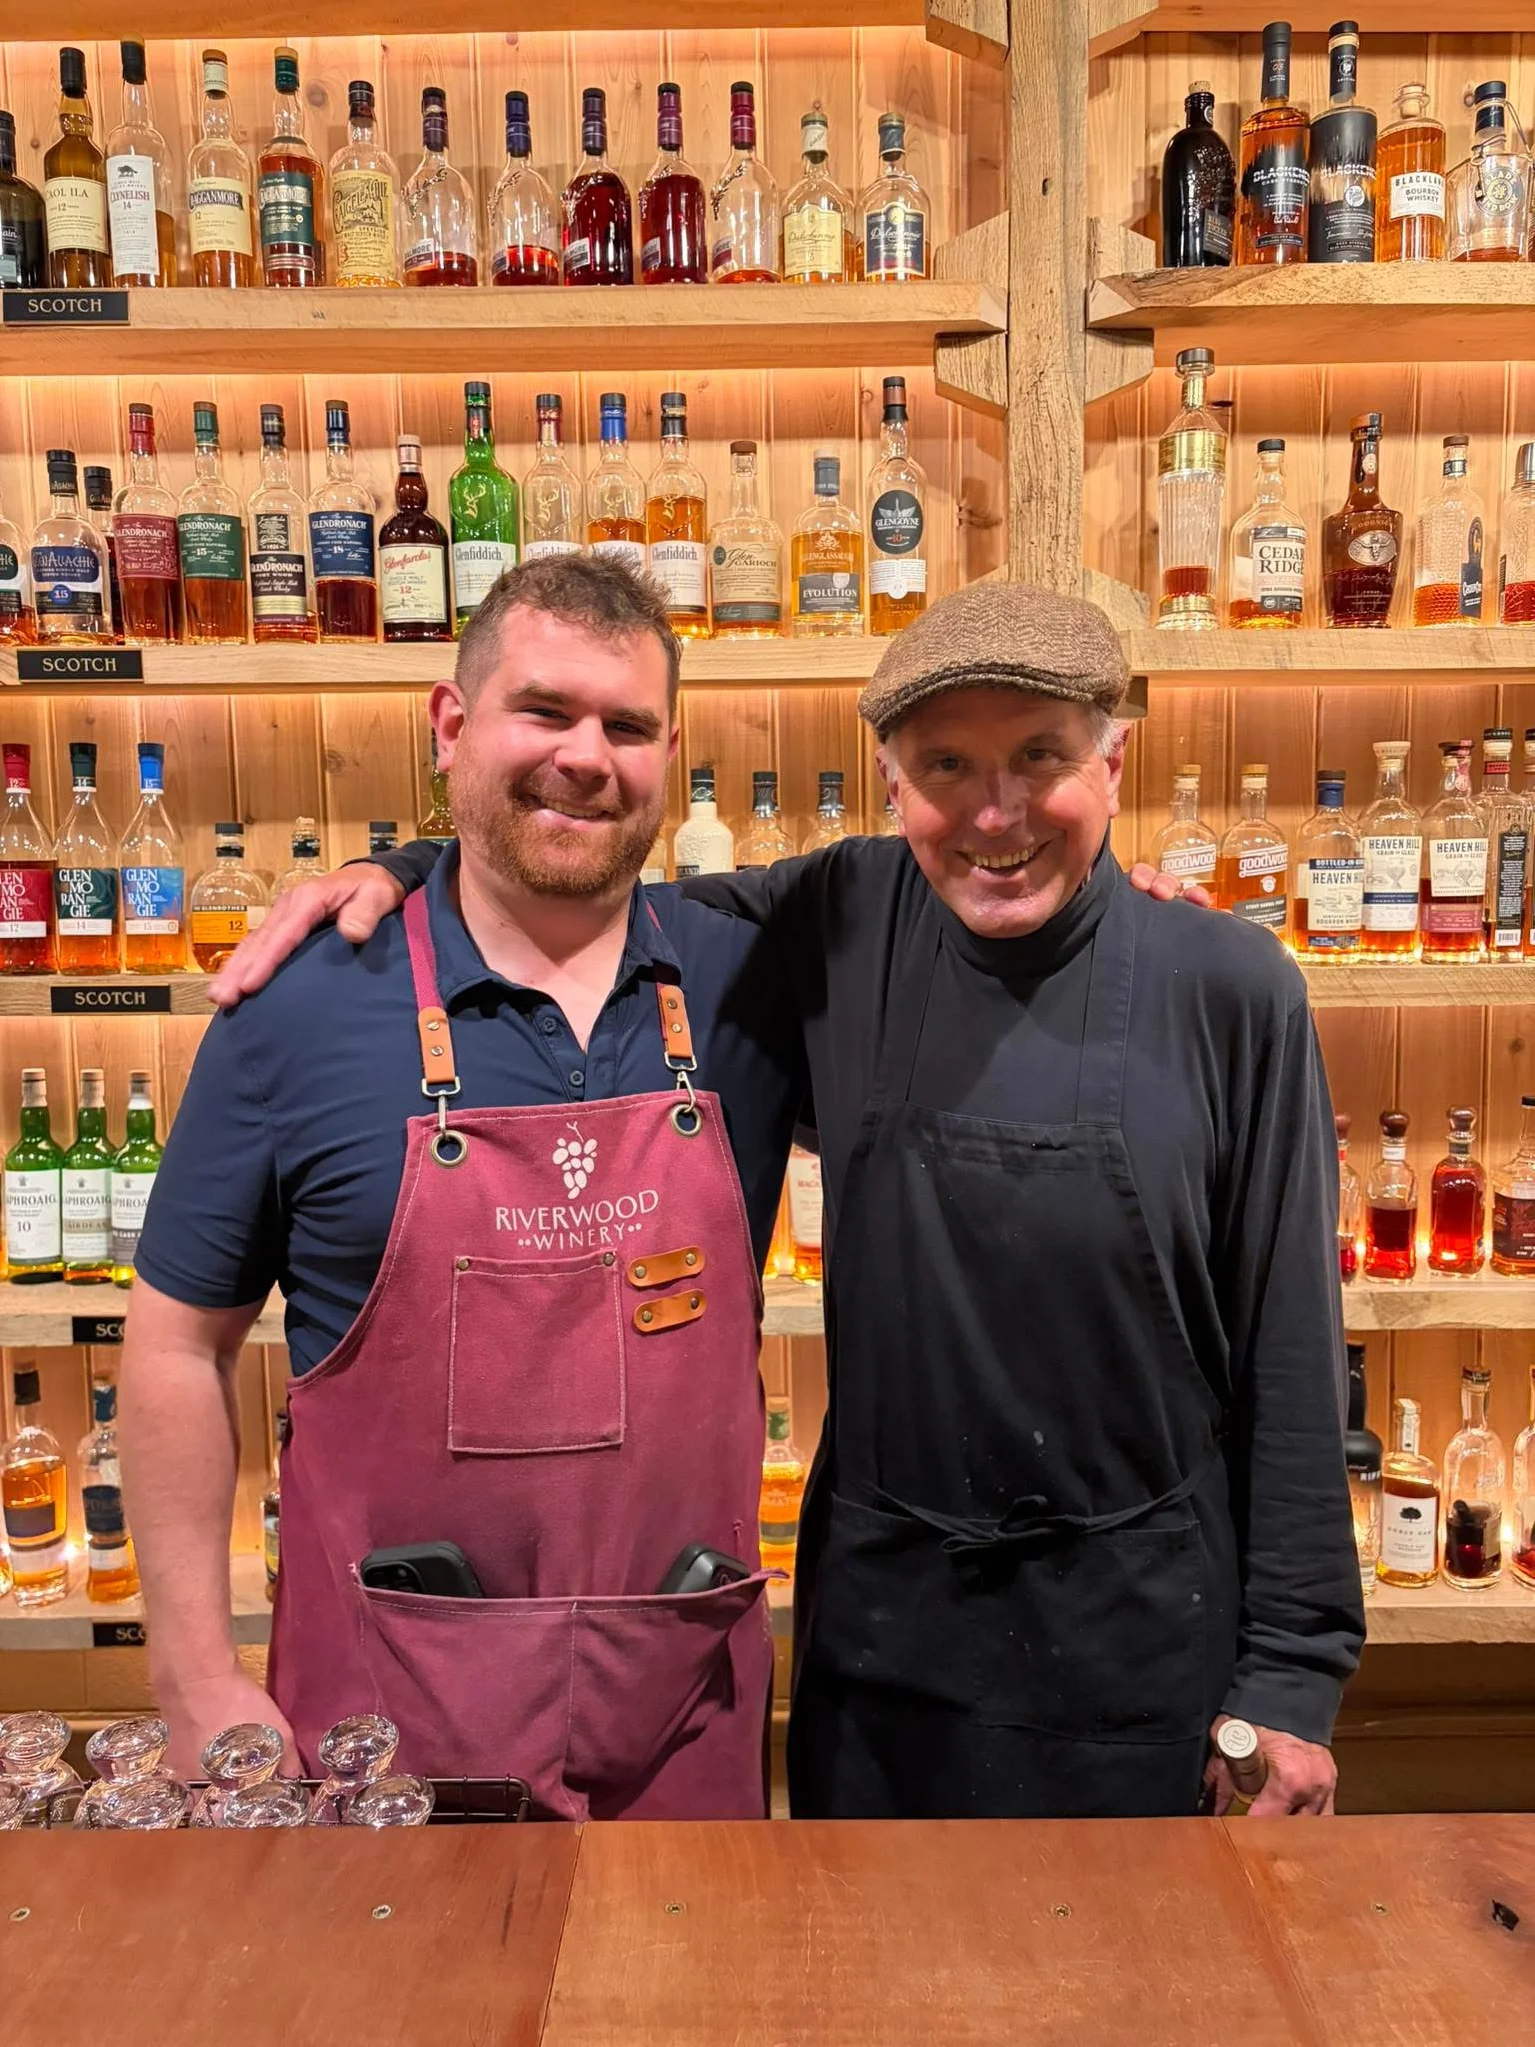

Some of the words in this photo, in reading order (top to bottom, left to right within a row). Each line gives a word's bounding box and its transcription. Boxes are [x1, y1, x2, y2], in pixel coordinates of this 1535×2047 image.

[70, 188, 88, 198] ILA
[1405, 187, 1439, 196] BOURBON
[123, 201, 132, 210] 14
[1407, 196, 1439, 204] WHISKEY
[58, 203, 67, 211] 12
[28, 298, 102, 313] SCOTCH
[312, 519, 367, 529] GLENDRONACH
[875, 517, 920, 527] GLENGOYNE
[196, 547, 207, 556] 15
[384, 549, 431, 574] Glenfarclas
[726, 548, 757, 568] Glen
[735, 559, 776, 568] GARIOCH
[54, 590, 69, 599] 15
[400, 585, 412, 594] 12
[803, 588, 857, 598] EVOLUTION
[42, 657, 117, 672] SCOTCH
[1368, 839, 1404, 849] HEAVEN
[1437, 842, 1473, 853] HEAVEN
[59, 869, 92, 882] GLEN
[126, 869, 158, 881] GLEN
[1312, 872, 1352, 884] HEAVEN
[70, 882, 94, 894] MO
[136, 881, 160, 893] MO
[61, 893, 85, 906] RAN
[128, 893, 152, 905] RAN
[3, 907, 24, 920] GIE
[70, 905, 91, 917] GIE
[137, 904, 158, 917] GIE
[229, 920, 243, 931] 12
[75, 991, 146, 1005] SCOTCH
[495, 1189, 659, 1231] RIVERWOOD
[17, 1221, 31, 1232] 10
[533, 1223, 625, 1251] WINERY
